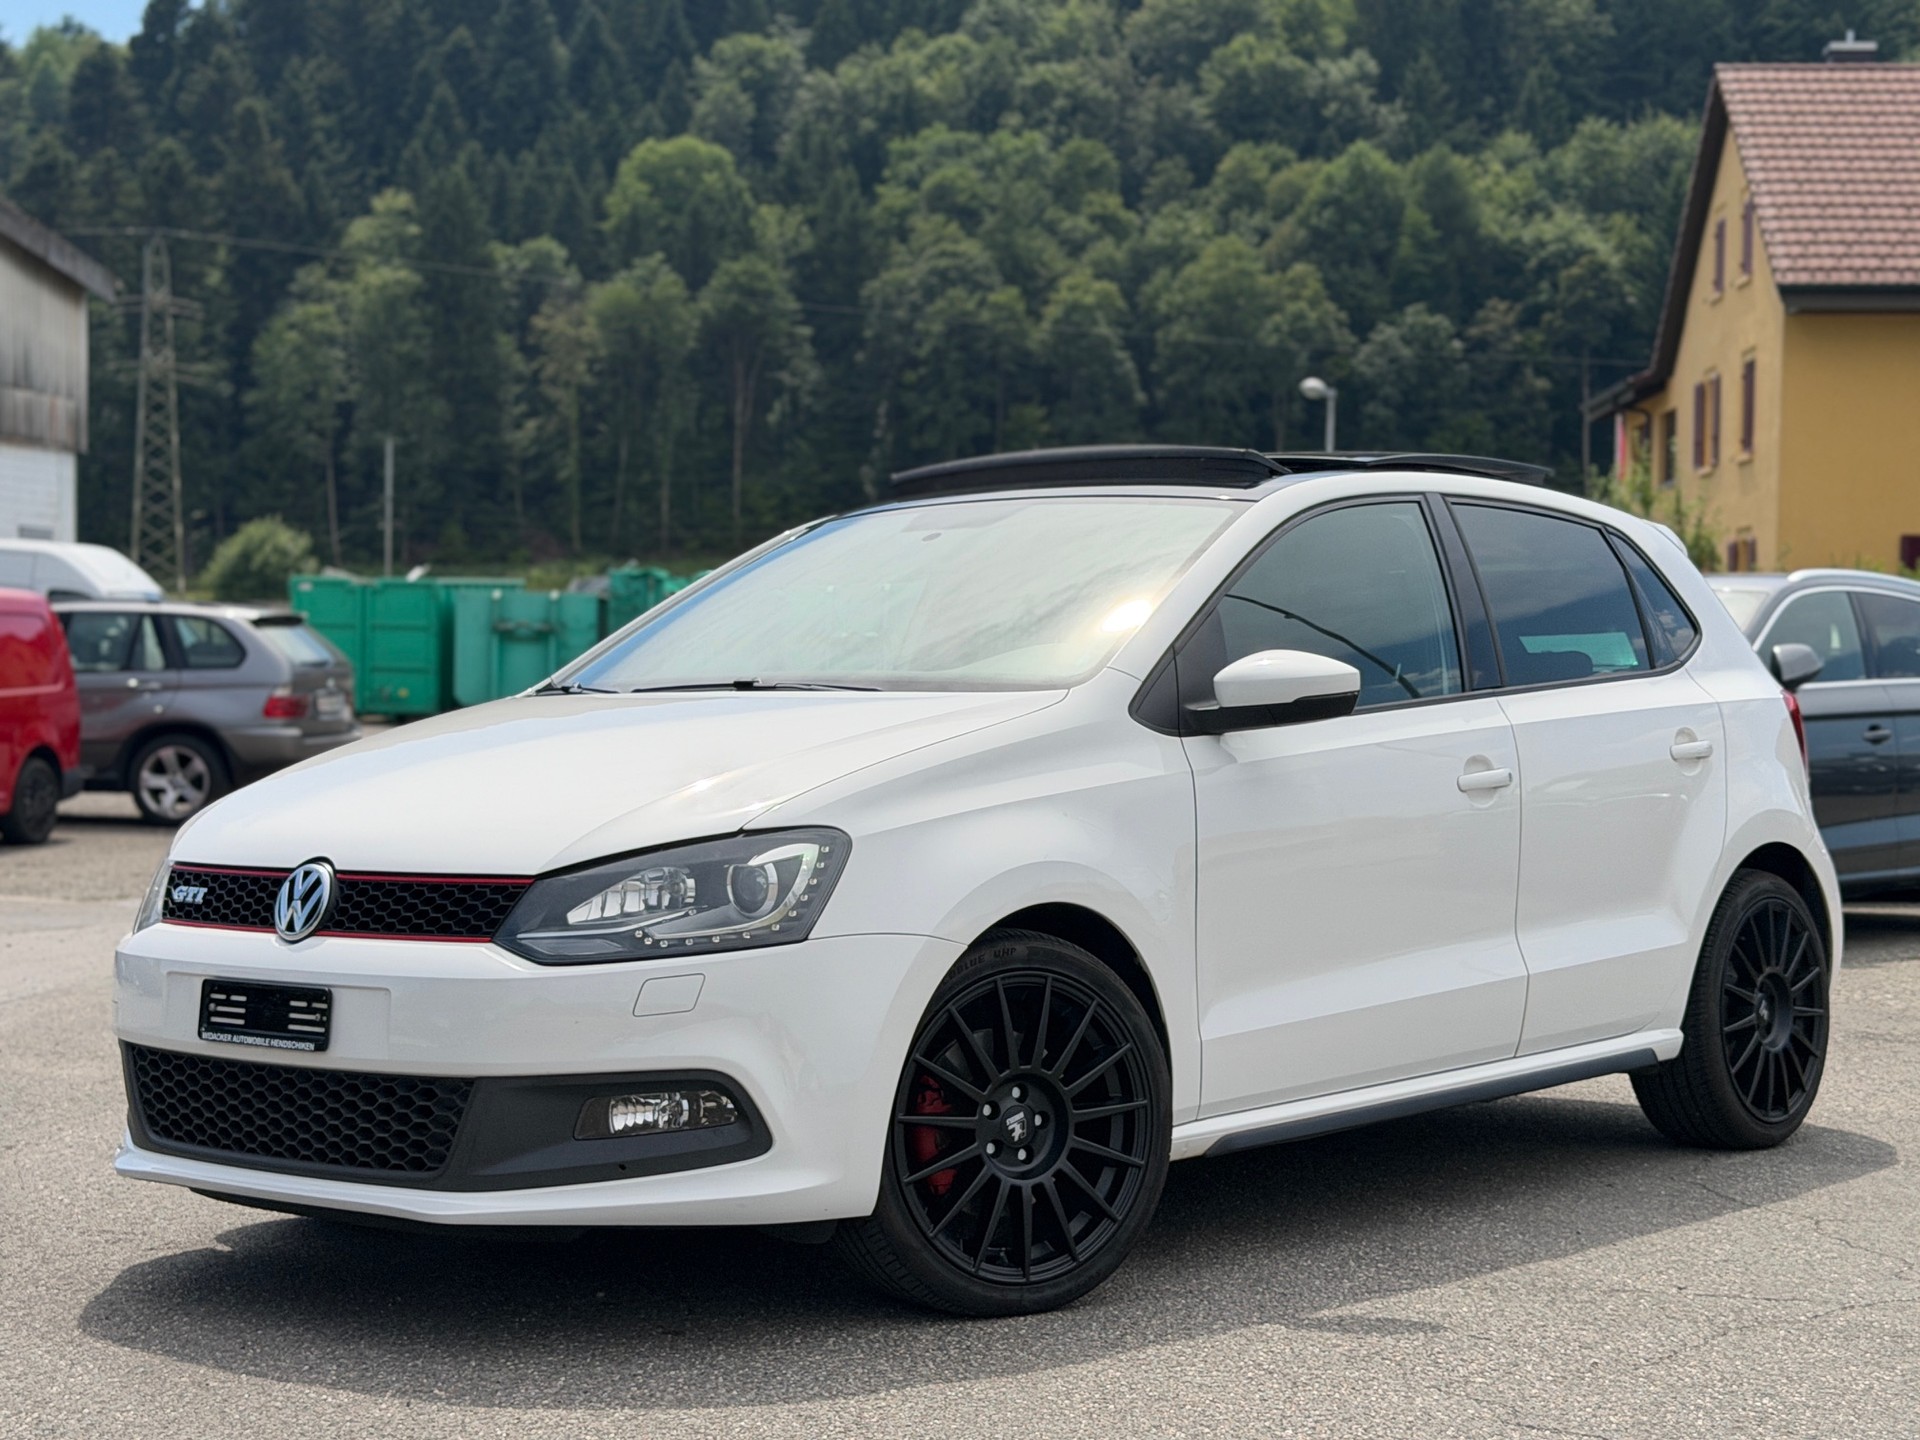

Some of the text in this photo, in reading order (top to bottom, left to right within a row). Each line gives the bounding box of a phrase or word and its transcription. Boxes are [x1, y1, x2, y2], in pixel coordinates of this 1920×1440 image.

[173, 886, 208, 904] GTI
[233, 1034, 271, 1046] AUTOMOBILE
[271, 1038, 315, 1051] HENDSCHIKEN
